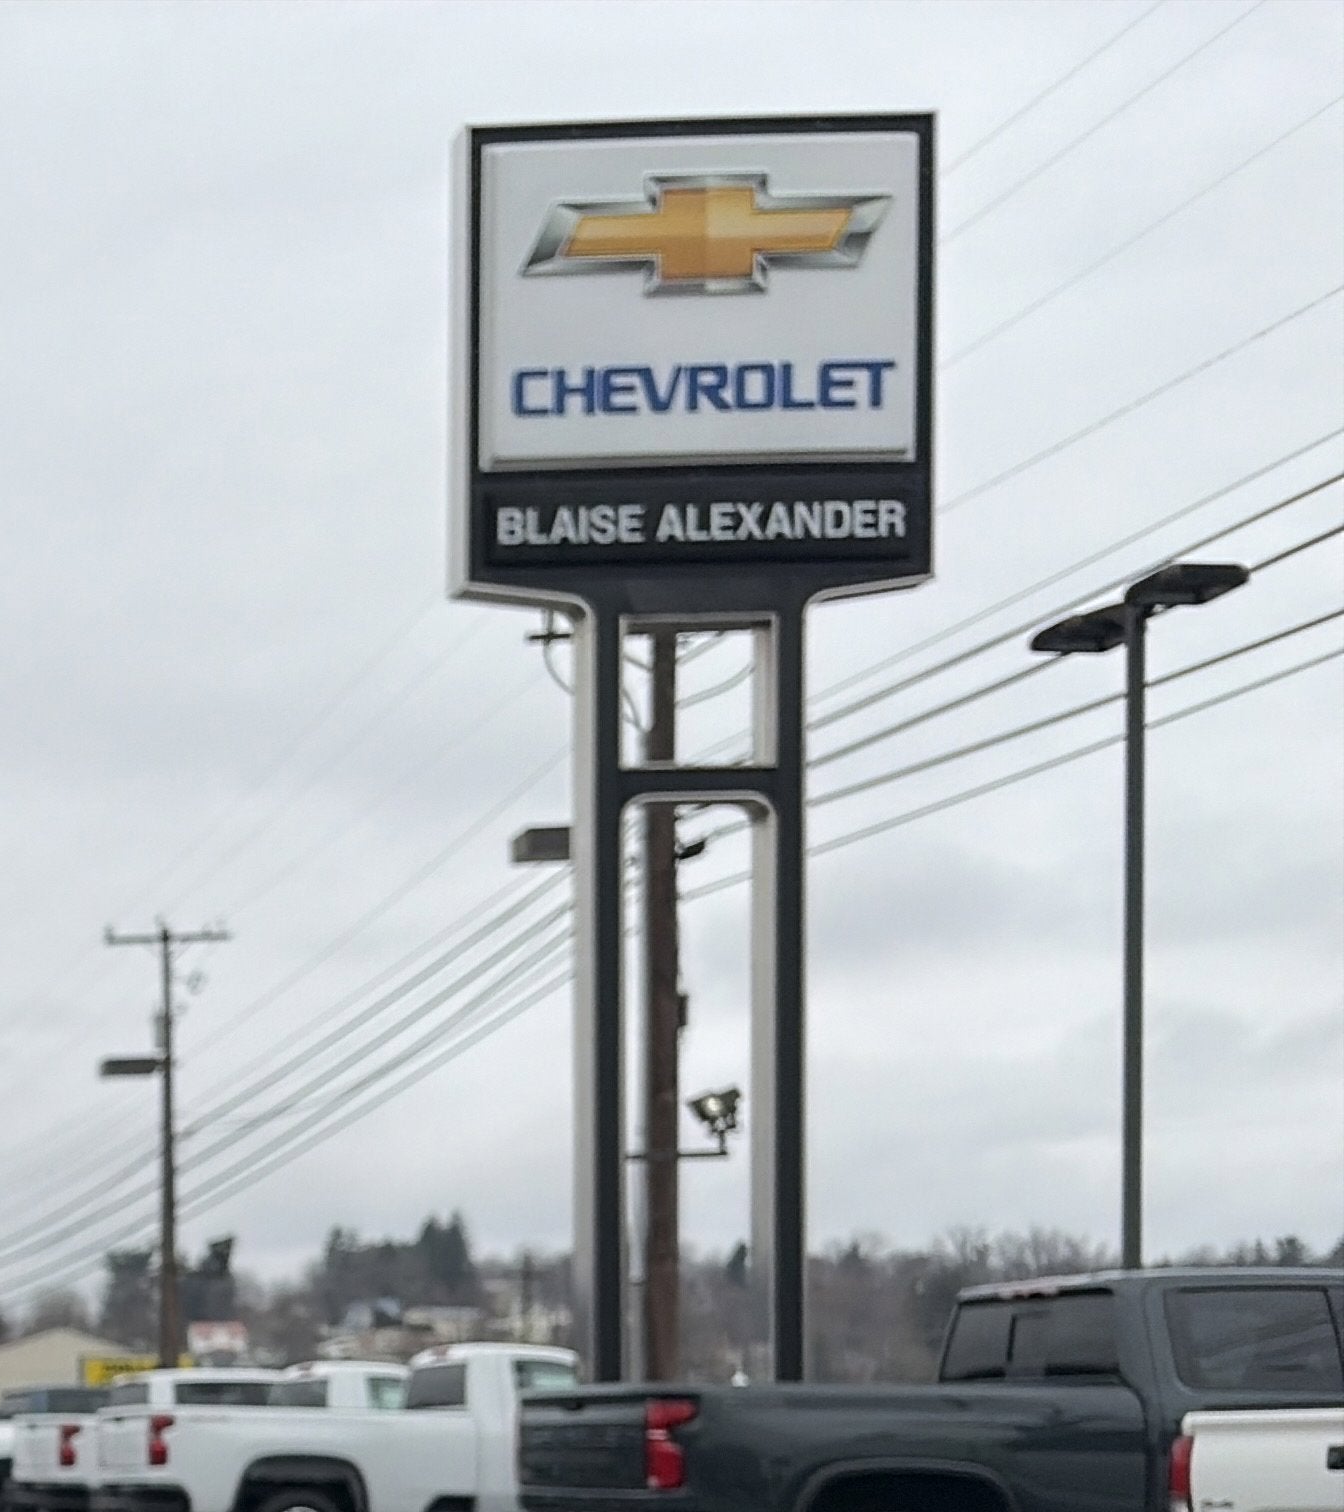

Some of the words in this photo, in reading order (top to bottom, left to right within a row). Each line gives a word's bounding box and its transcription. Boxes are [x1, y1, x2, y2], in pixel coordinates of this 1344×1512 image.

[514, 361, 895, 416] CHEVROLET
[497, 505, 645, 545] BLAISE
[656, 501, 906, 542] ALEXANDER
